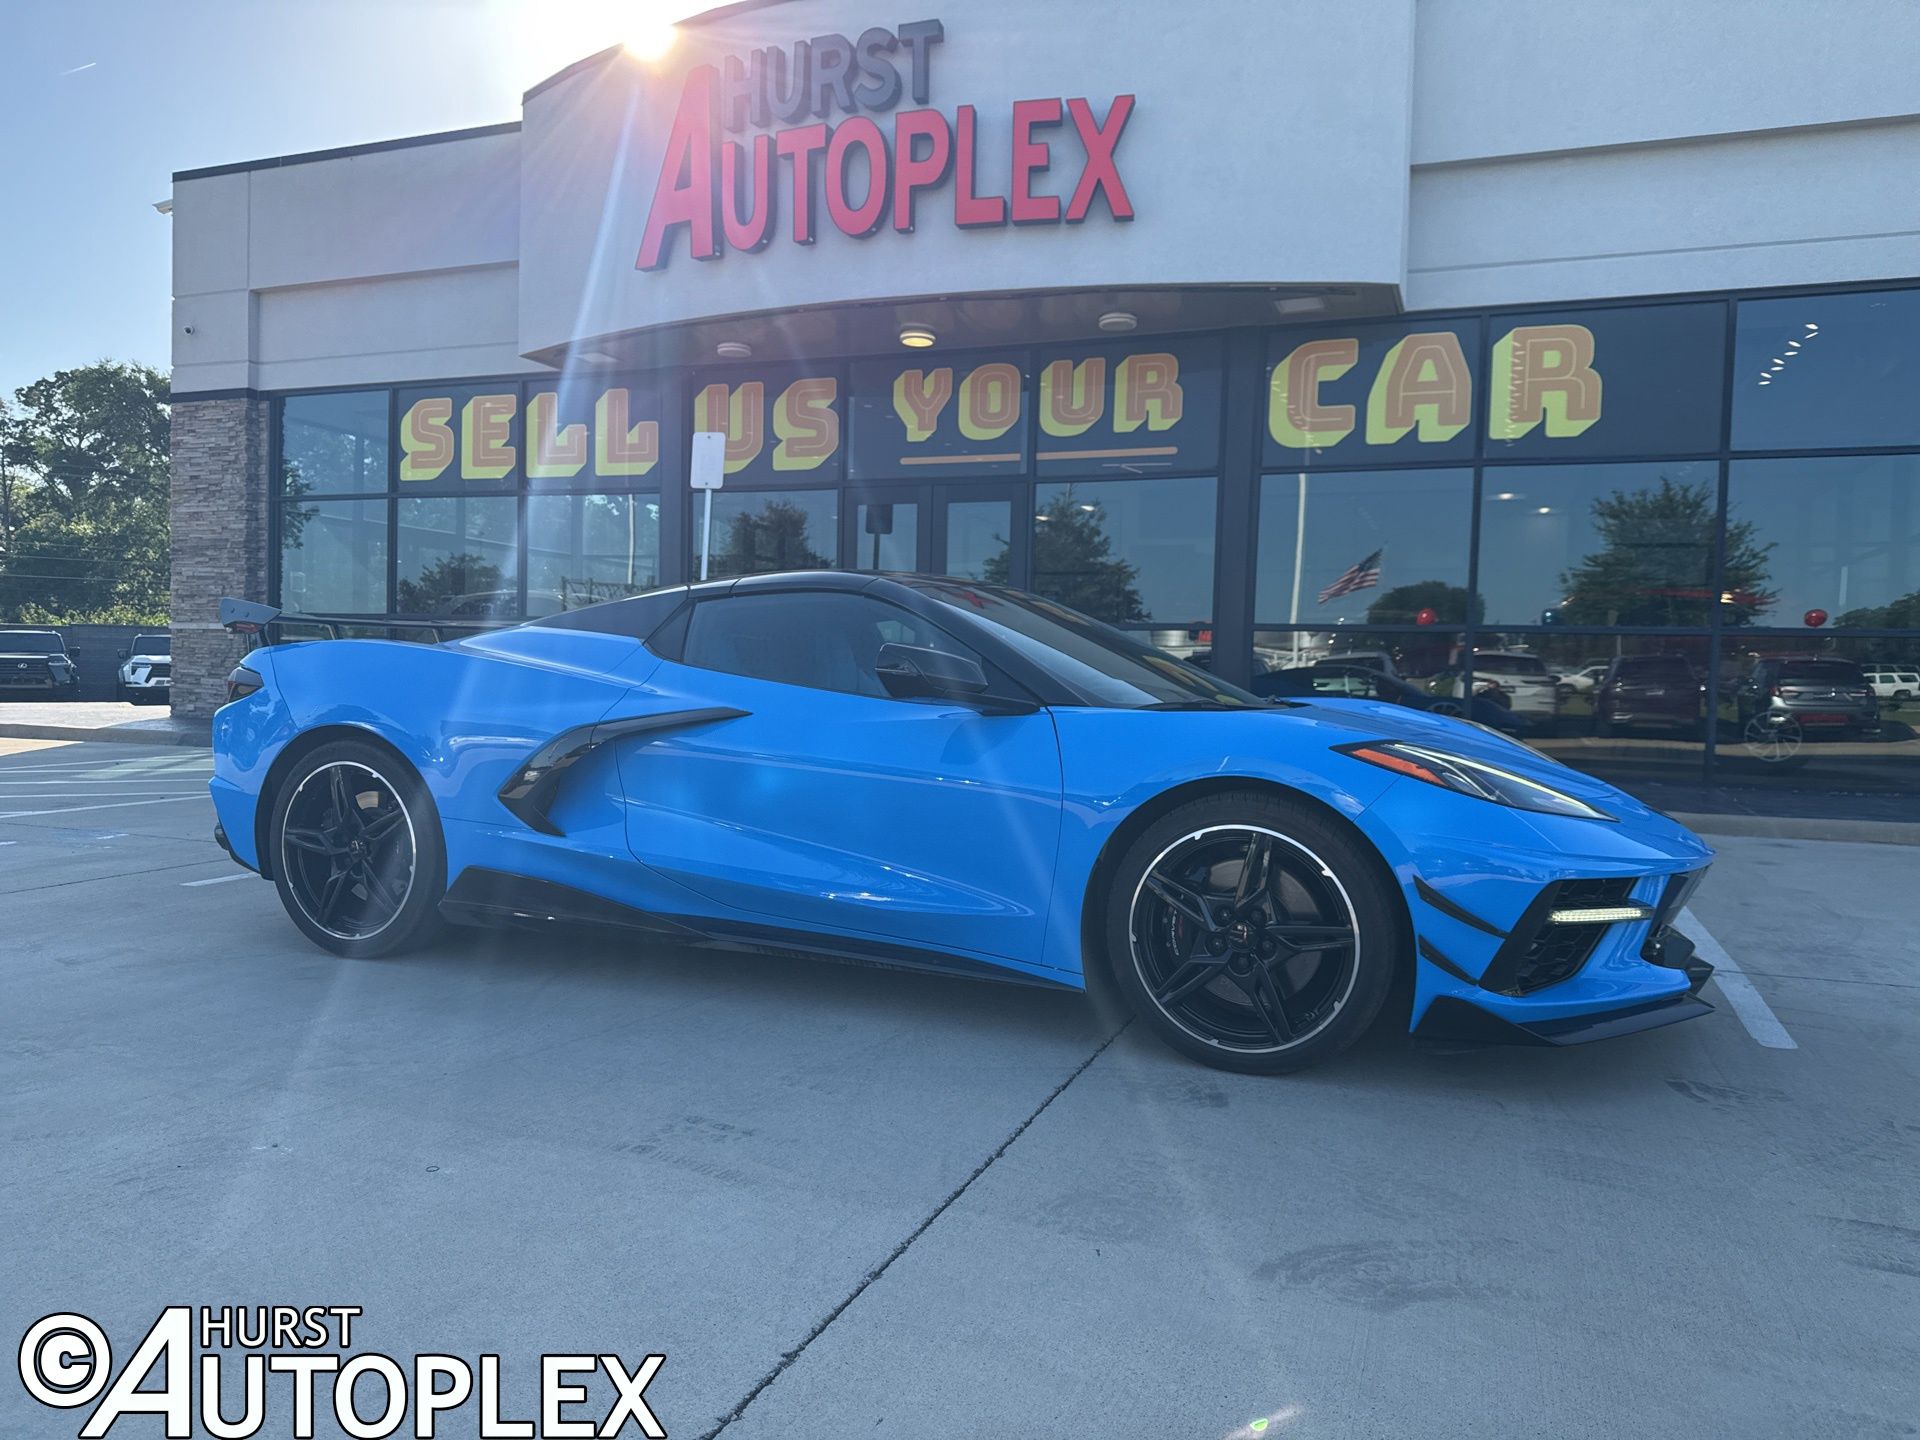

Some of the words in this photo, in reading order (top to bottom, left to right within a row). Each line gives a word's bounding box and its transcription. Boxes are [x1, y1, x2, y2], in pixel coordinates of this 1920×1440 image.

[722, 18, 944, 132] HURST
[635, 63, 1135, 272] AUTOPLEX
[400, 387, 659, 481] SELL
[693, 376, 839, 475] US
[893, 353, 1183, 442] YOUR
[1268, 324, 1602, 449] CAR
